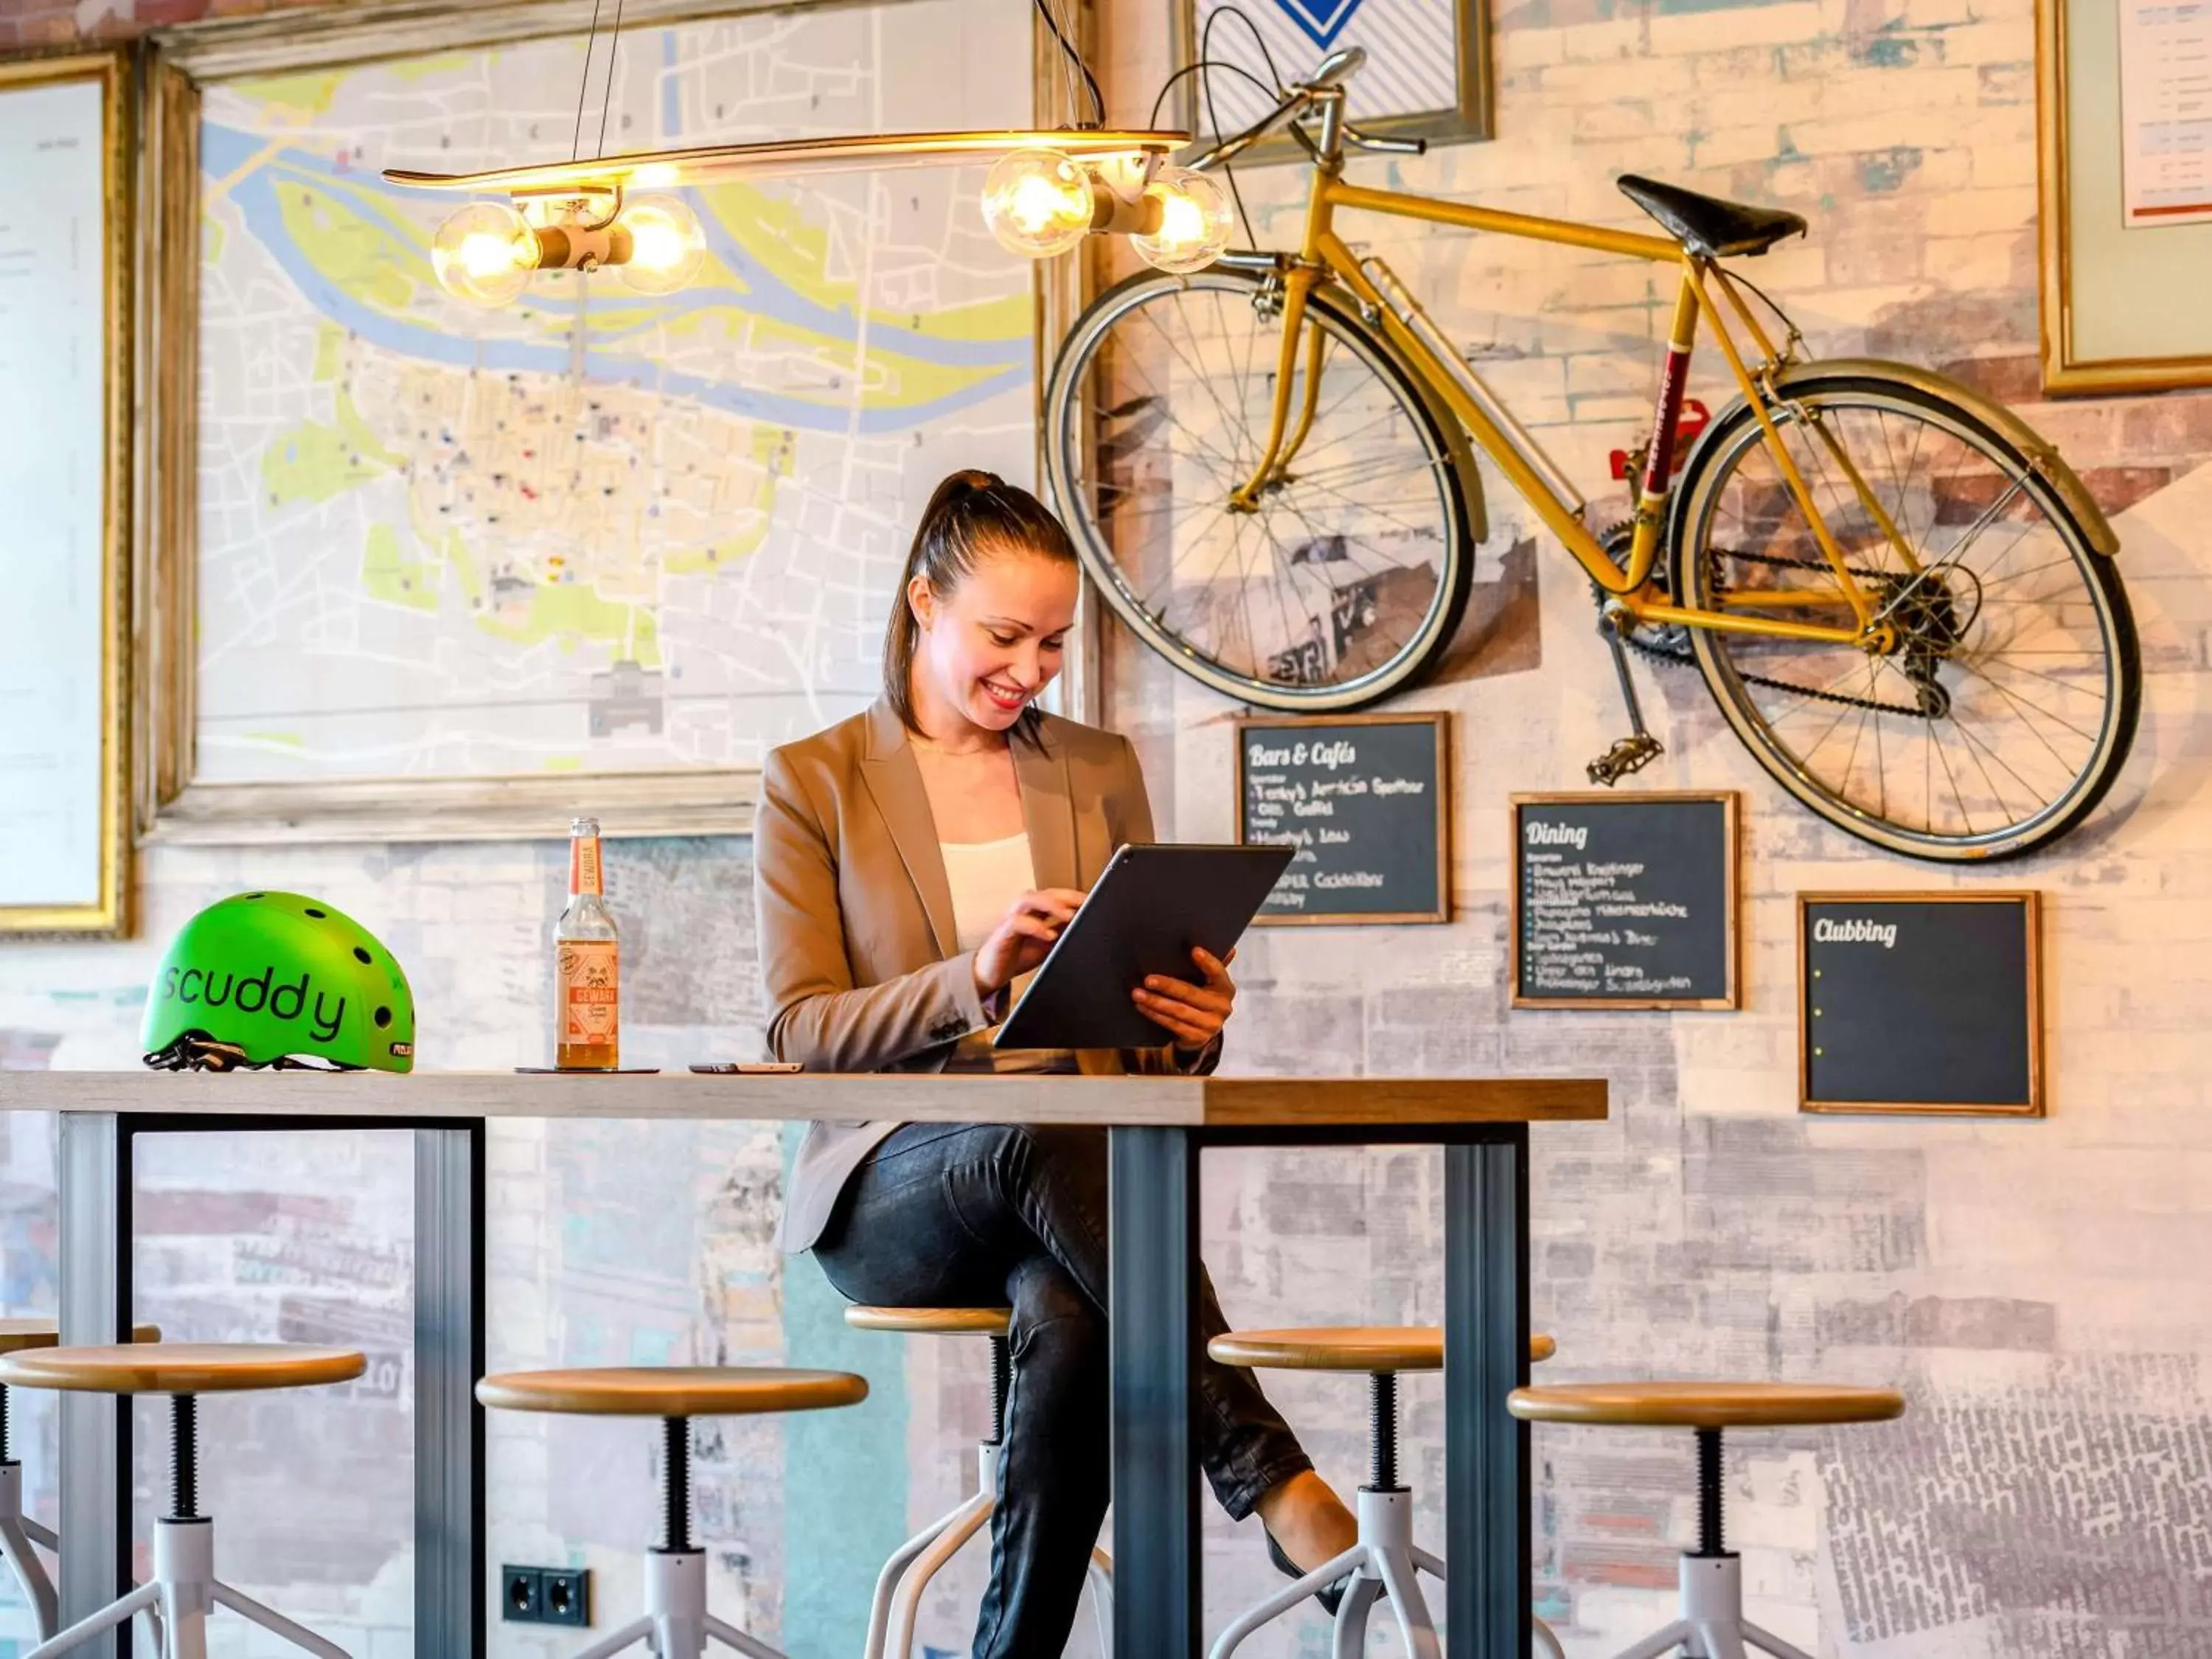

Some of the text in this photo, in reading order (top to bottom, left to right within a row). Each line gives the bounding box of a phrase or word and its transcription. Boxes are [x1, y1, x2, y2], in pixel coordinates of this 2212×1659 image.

[1249, 741, 1356, 770] Bars & Cafés
[1526, 821, 1588, 850] Dining
[1814, 918, 1896, 948] Clubbing
[162, 966, 346, 1043] scuddy
